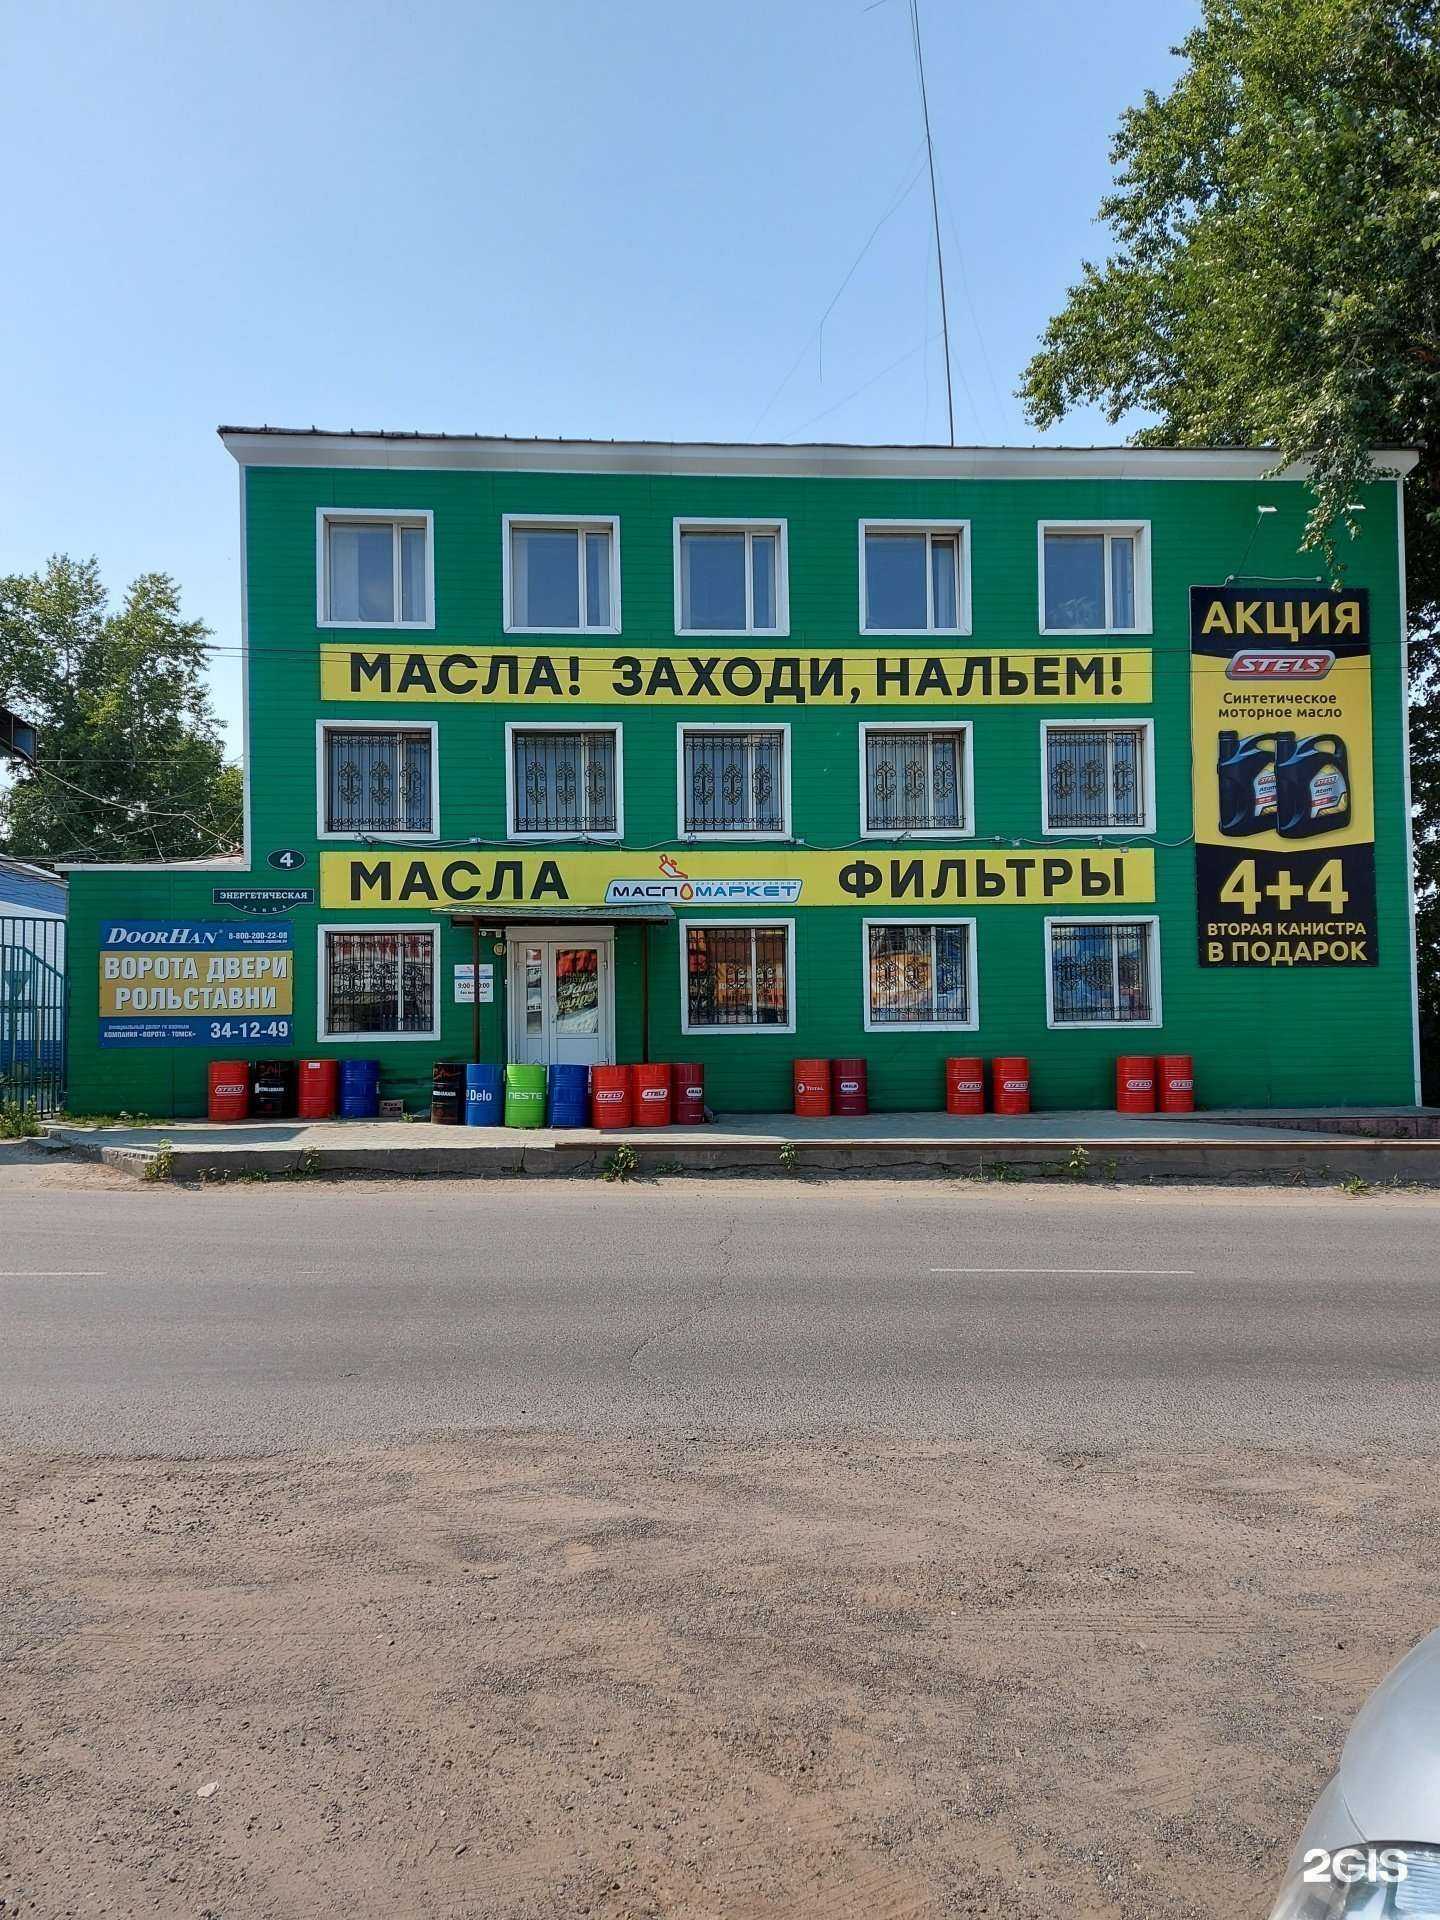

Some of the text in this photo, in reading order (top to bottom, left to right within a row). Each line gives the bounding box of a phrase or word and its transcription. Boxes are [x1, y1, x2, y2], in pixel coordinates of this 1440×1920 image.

[1201, 601, 1361, 642] АКЦИЯ
[1236, 657, 1325, 673] STELS
[350, 652, 1123, 704] МАСЛА! ЗАХОДИ, НАЛЬЕМ!
[1223, 692, 1337, 705] Синтетическое
[1218, 707, 1342, 720] моторное масло
[279, 852, 294, 867] 4
[350, 860, 570, 901] МАСЛА
[838, 857, 1125, 899] ФИЛЬТРЫ
[1220, 859, 1349, 915] 4+4
[219, 891, 308, 900] ЭНЕРГЕТИЧЕСКАЯ
[1207, 922, 1367, 936] ВТОРАЯ КАНИСТРА
[1208, 941, 1368, 966] В ПОДАРОК
[104, 956, 288, 983] ВОРОТА ДВЕРИ
[115, 986, 277, 1010] РОЛЬСТАВНИ
[210, 1021, 289, 1039] 34-12-49
[470, 1089, 492, 1102] Delo
